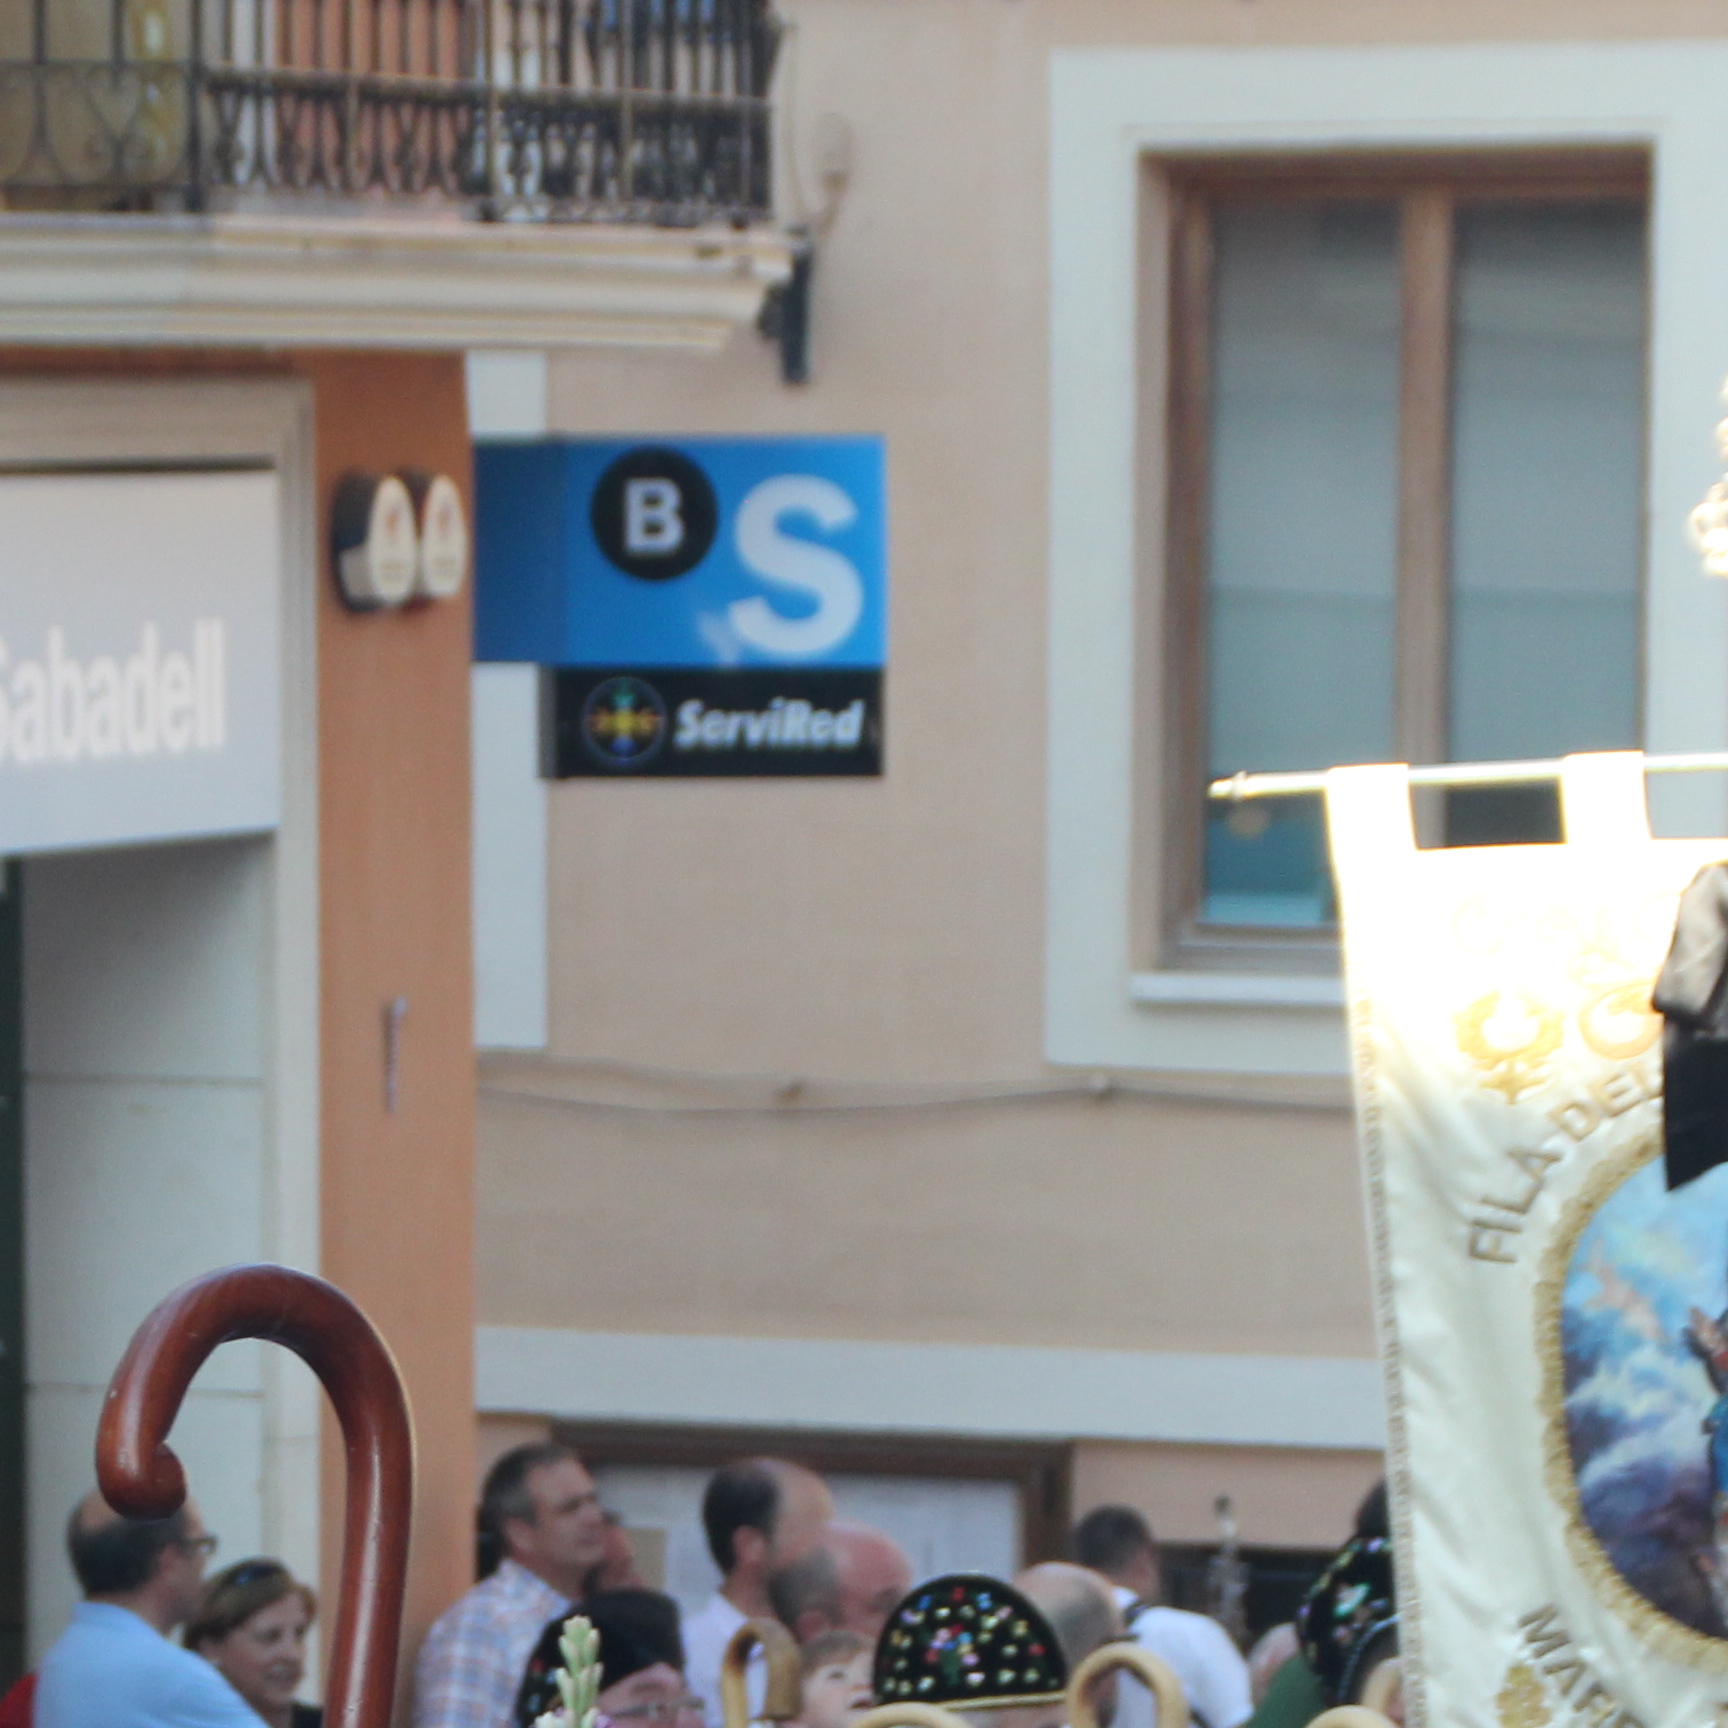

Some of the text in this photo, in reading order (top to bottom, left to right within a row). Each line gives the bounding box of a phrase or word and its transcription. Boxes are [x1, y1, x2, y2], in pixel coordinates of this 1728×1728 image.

[625, 472, 863, 660] B S
[674, 696, 865, 748] ServiRed
